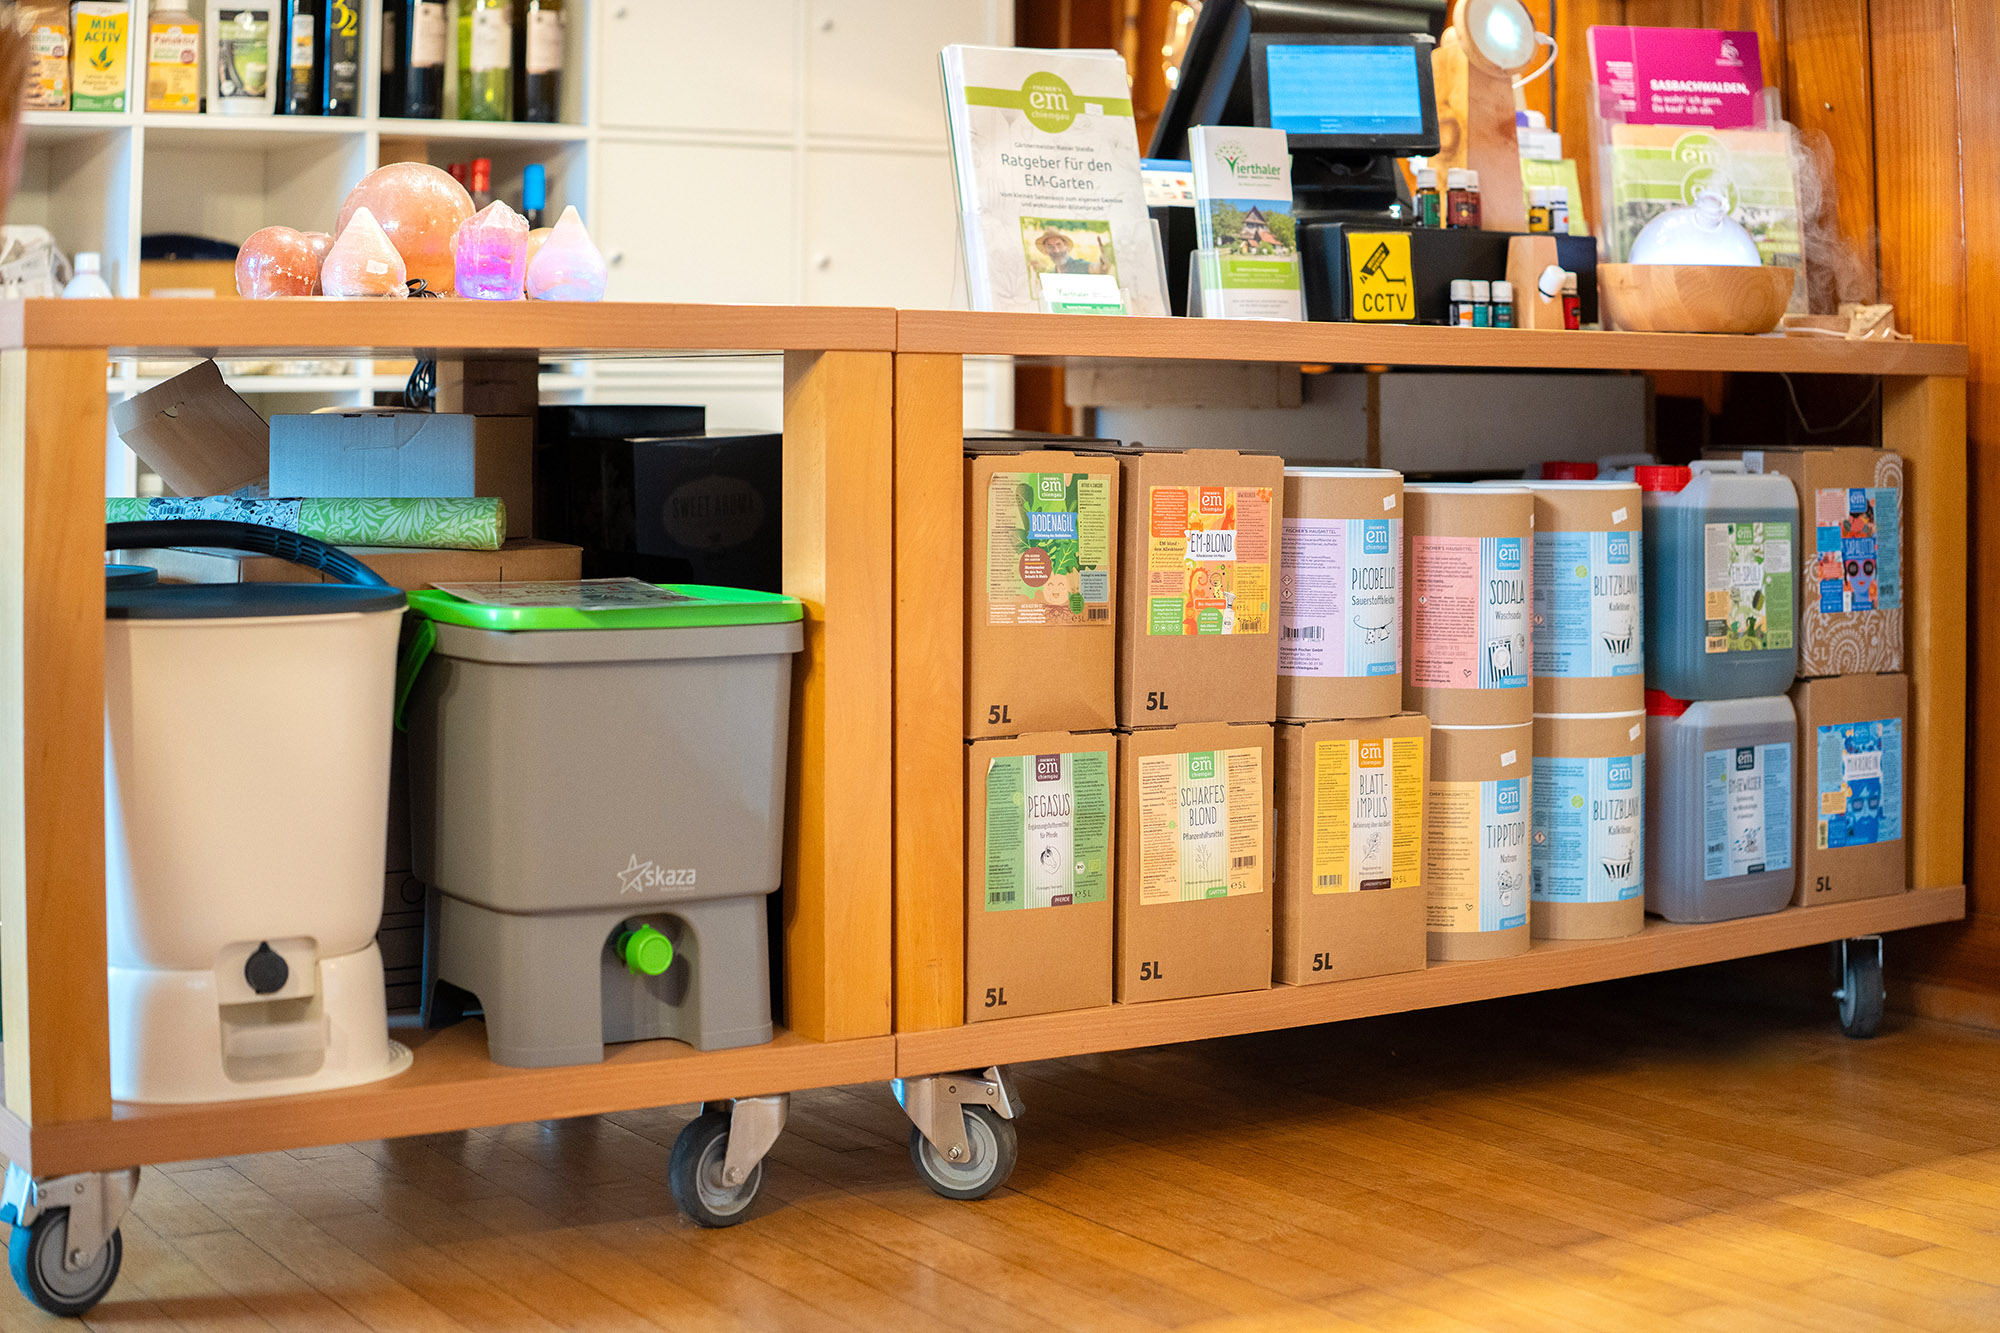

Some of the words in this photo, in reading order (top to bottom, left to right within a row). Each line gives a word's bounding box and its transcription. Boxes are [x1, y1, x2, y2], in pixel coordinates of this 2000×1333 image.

[91, 20, 116, 30] MIN
[84, 32, 121, 43] ACTIV
[1030, 92, 1069, 111] em
[1001, 153, 1060, 170] Ratgeber
[1064, 156, 1083, 170] für
[1088, 158, 1112, 172] den
[1224, 155, 1280, 177] Vierthaler
[1025, 173, 1094, 189] EM-Garten
[1362, 293, 1408, 312] CCTV
[1041, 480, 1062, 492] em
[1202, 495, 1222, 506] em
[1191, 533, 1232, 553] EM-BLOND
[1366, 531, 1387, 543] em
[1499, 548, 1519, 561] em
[1609, 543, 1629, 555] em
[1489, 579, 1525, 605] SODALA
[1146, 692, 1169, 710] 5L
[988, 705, 1012, 724] 5L
[1361, 747, 1381, 759] em
[1738, 754, 1753, 764] em
[1038, 762, 1058, 774] em
[1191, 760, 1212, 772] em
[1609, 767, 1631, 781] em
[1360, 774, 1388, 795] BLATT-
[1181, 784, 1225, 807] SCHARFES
[1499, 790, 1519, 804] em
[1028, 793, 1071, 819] PEGASUS
[1189, 806, 1217, 827] BLOND
[1183, 830, 1224, 841] Pflanzenhilfsmittel
[1500, 853, 1517, 864] Natron
[645, 865, 696, 886] skaza
[1816, 876, 1832, 892] 5L
[1312, 953, 1333, 972] 5L
[1140, 961, 1163, 981] 5L
[984, 988, 1008, 1008] 5L
